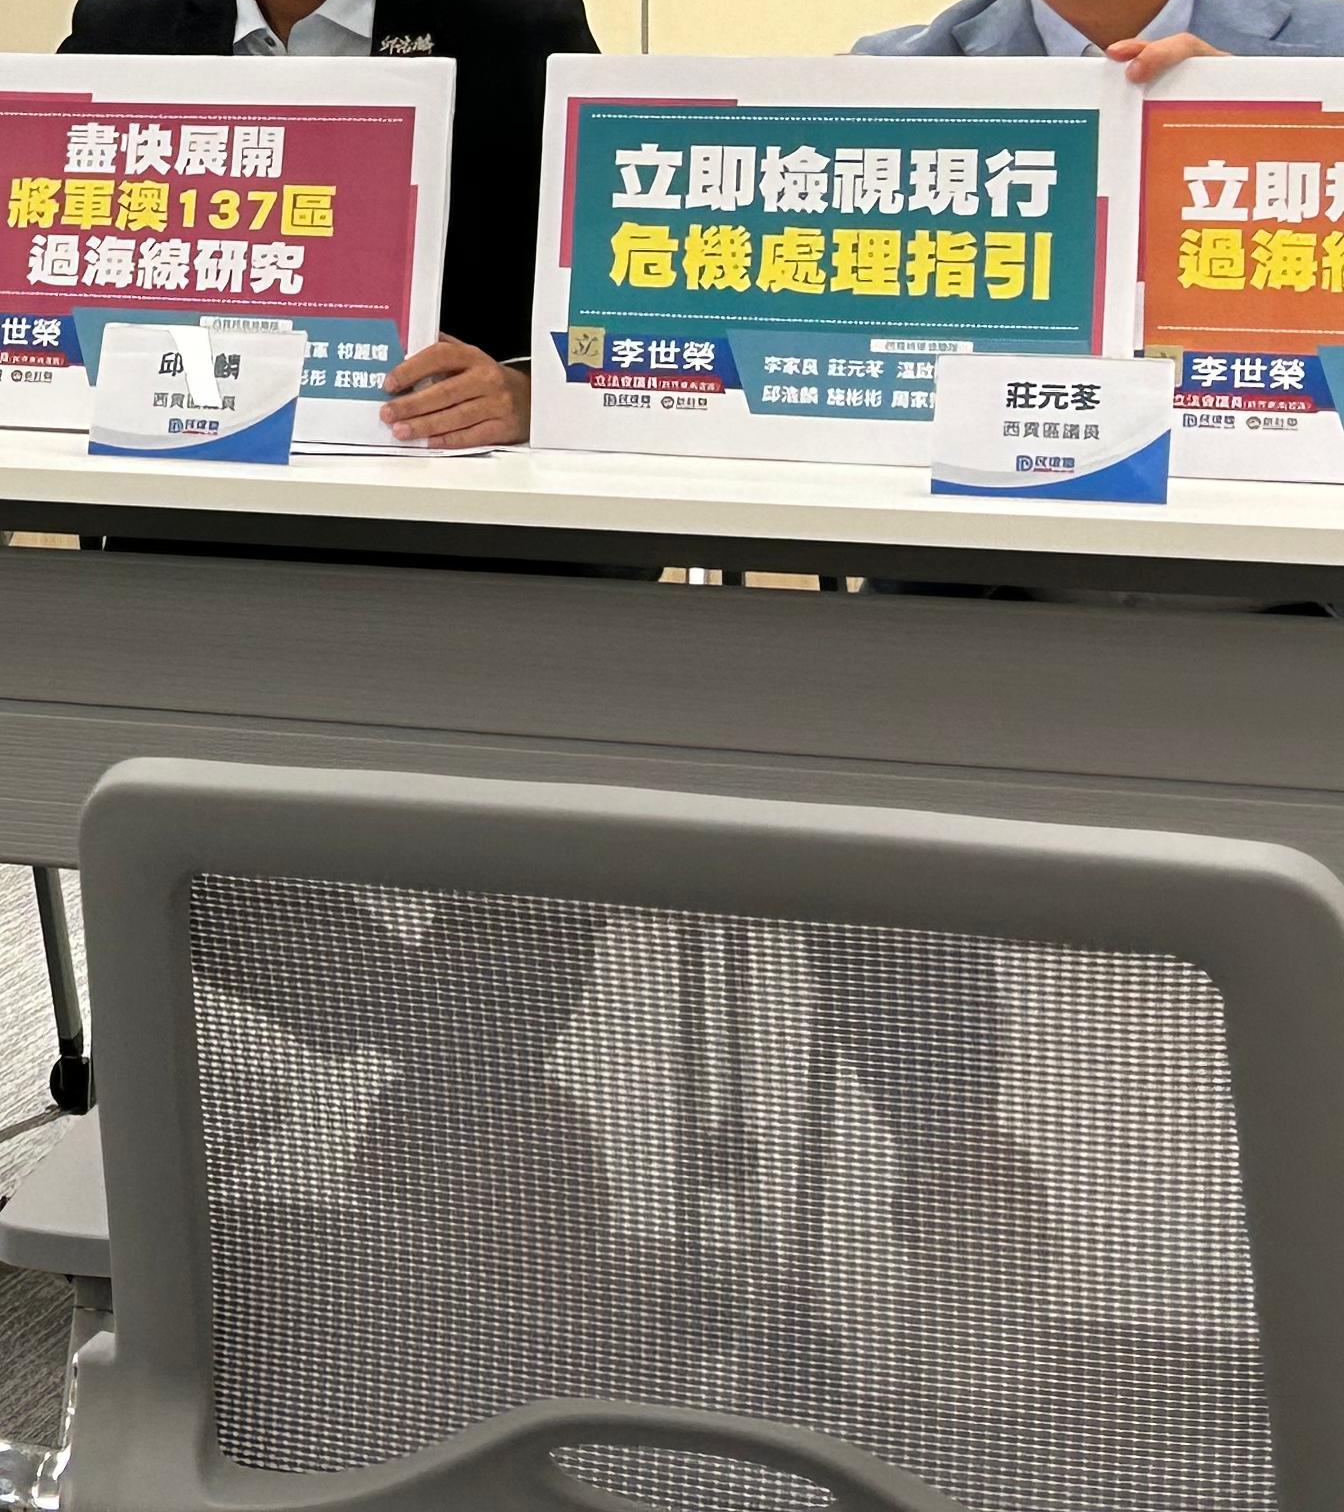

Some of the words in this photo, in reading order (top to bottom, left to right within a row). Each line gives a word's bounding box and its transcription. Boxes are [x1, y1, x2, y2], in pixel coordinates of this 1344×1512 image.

[64, 123, 286, 178] 盡快展開
[611, 142, 1057, 218] 立即檢視現行
[7, 176, 336, 238] 將軍澳137區
[25, 233, 306, 295] 過海線研究
[608, 221, 1054, 301] 危機處理指引
[612, 338, 715, 371] 李世榮
[1191, 356, 1305, 390] 李世榮
